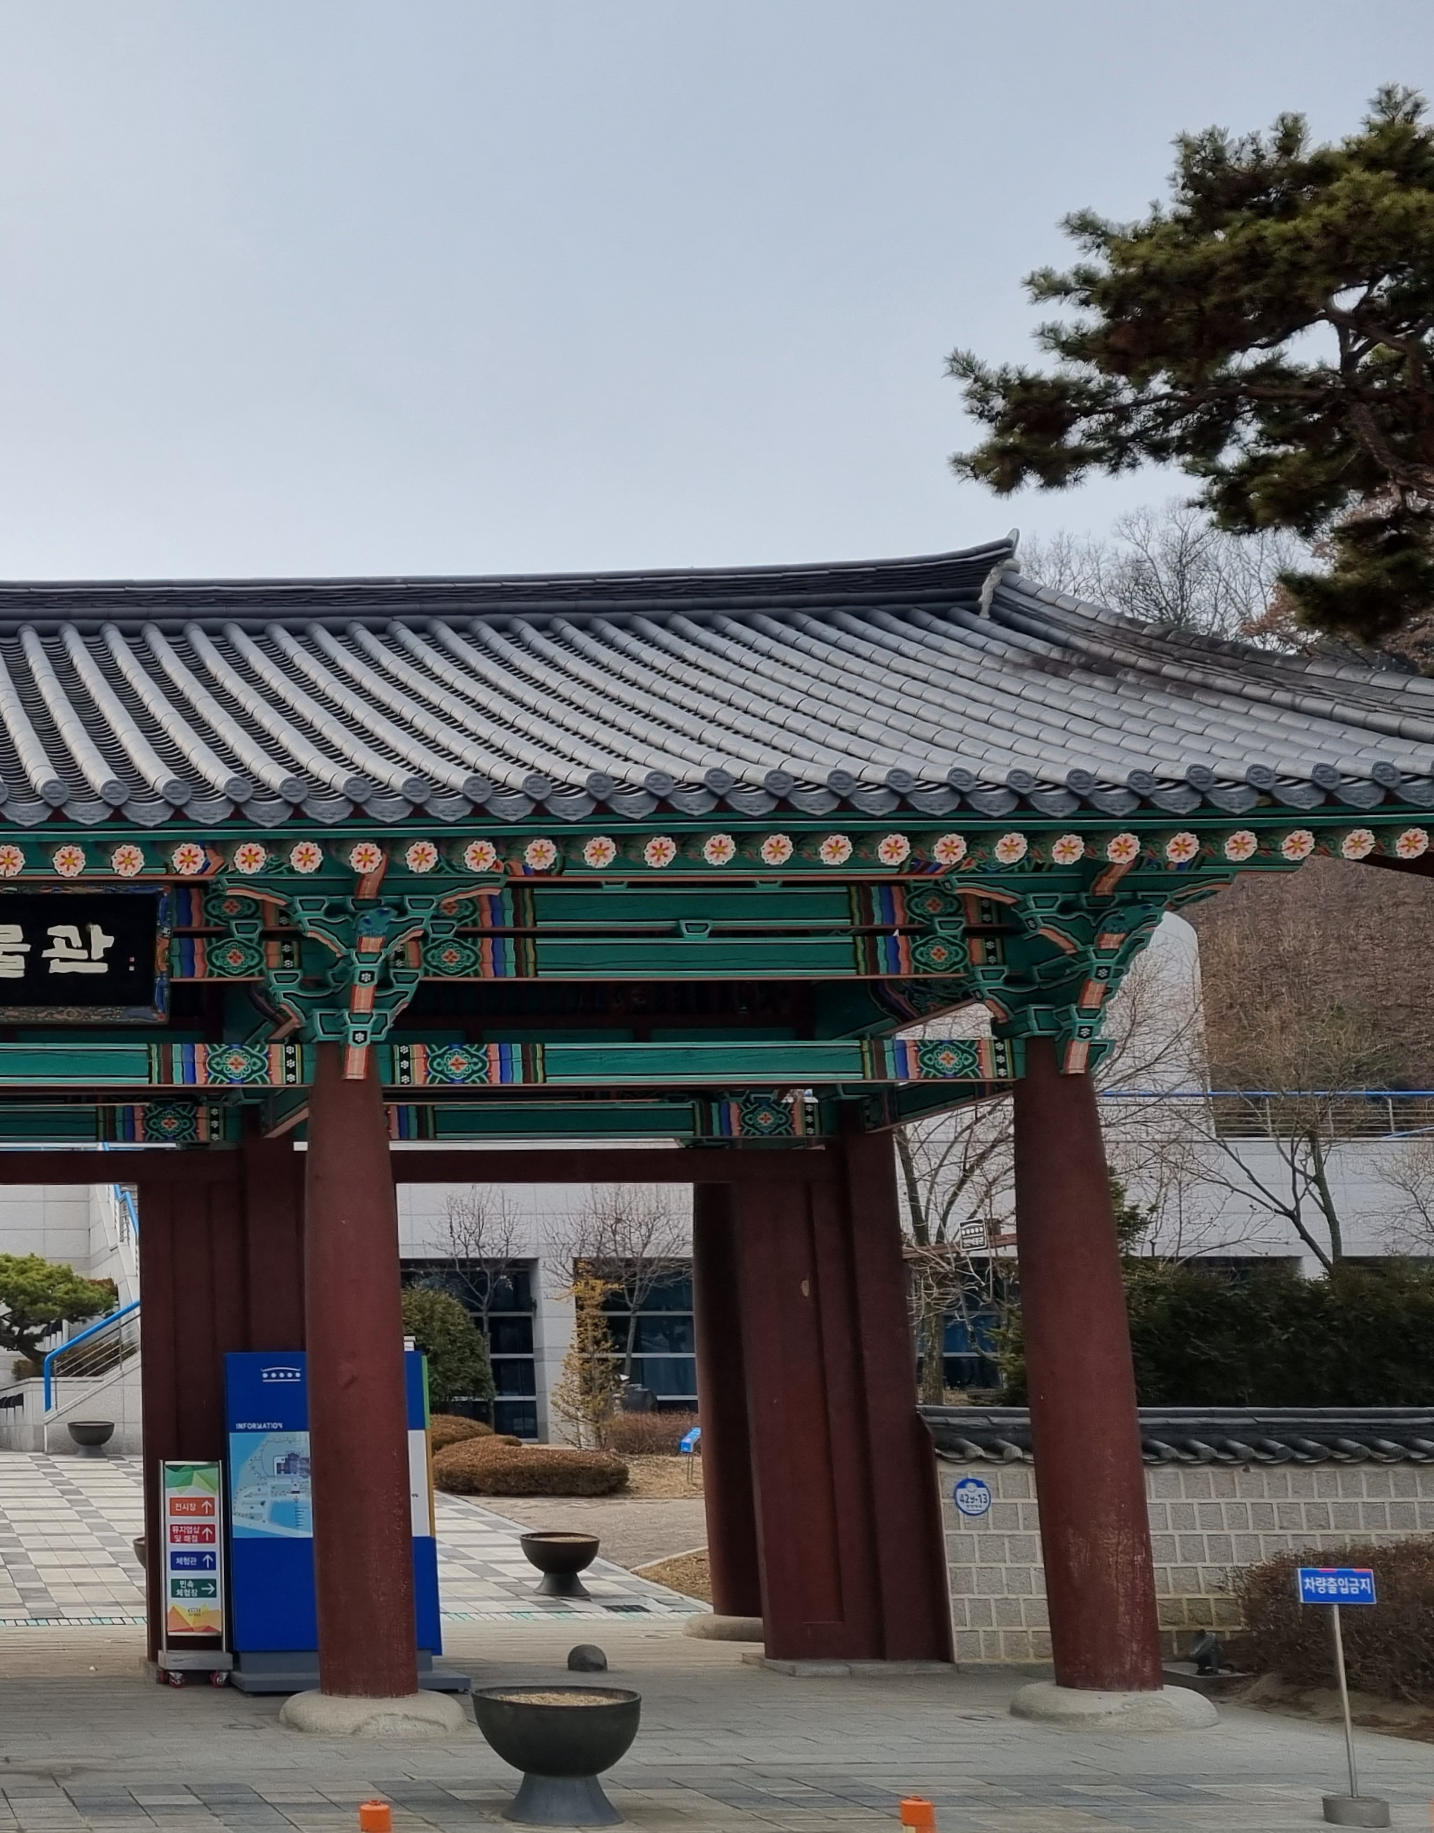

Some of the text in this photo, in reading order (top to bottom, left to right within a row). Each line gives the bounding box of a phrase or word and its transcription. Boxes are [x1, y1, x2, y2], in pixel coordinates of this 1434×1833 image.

[235, 1422, 283, 1430] INFORMATION
[175, 1502, 197, 1512] 전시장
[175, 1556, 197, 1566] 체험관
[1304, 1576, 1372, 1595] 차량출입금지
